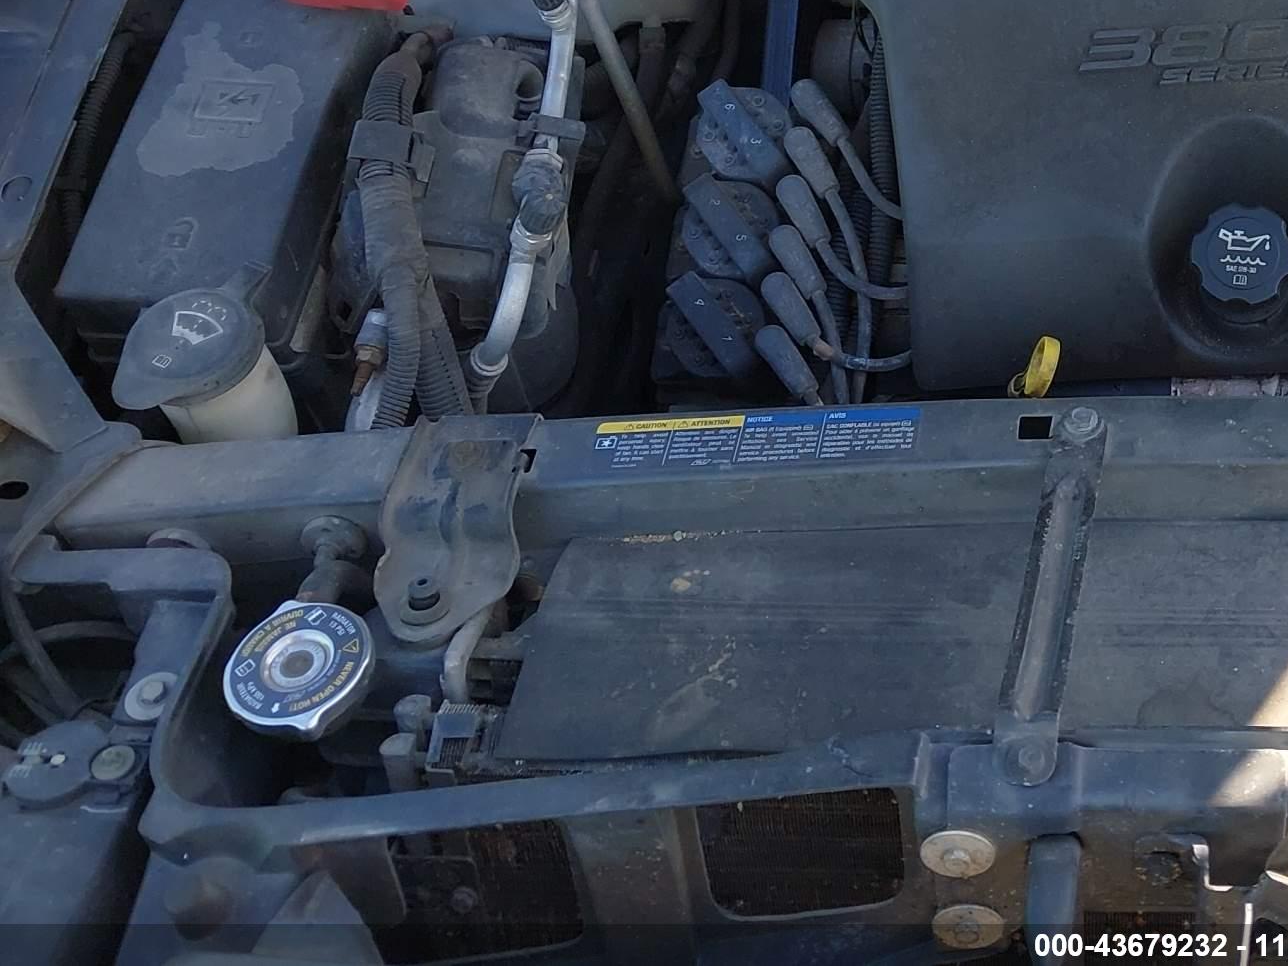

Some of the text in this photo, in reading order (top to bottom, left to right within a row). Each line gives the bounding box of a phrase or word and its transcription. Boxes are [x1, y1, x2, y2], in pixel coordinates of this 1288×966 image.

[635, 422, 667, 430] CAUTION
[690, 418, 731, 427] ATTENTION
[332, 660, 355, 687] NEVER
[312, 685, 336, 704] OPEN
